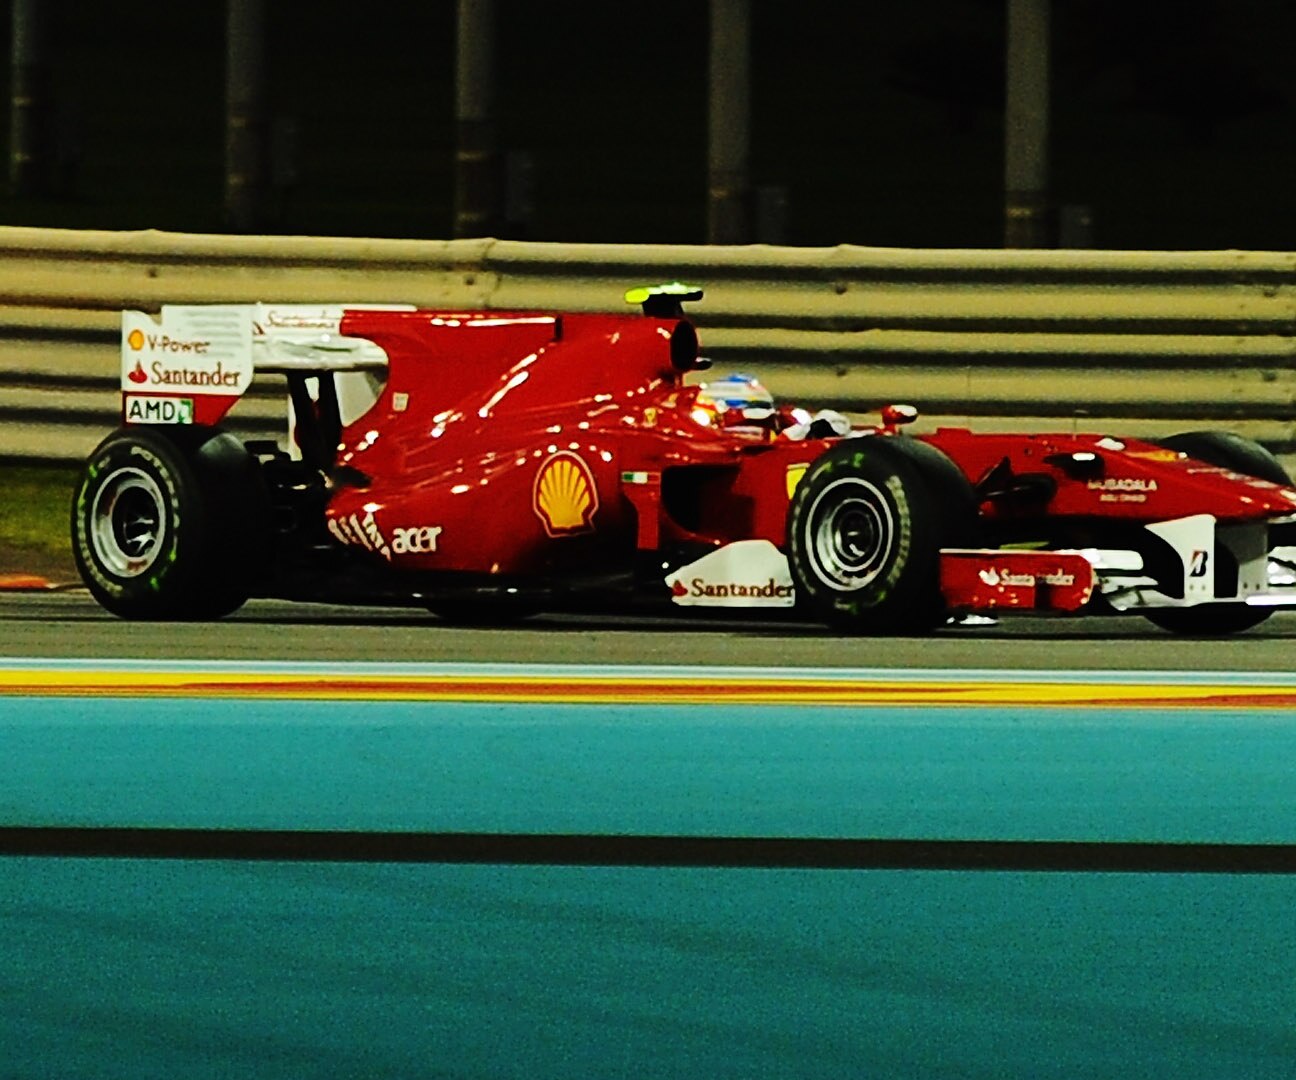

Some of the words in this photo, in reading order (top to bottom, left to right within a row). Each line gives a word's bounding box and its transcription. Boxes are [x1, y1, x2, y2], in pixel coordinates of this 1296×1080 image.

[148, 334, 211, 354] V-Power
[151, 361, 240, 387] Santander
[129, 400, 175, 421] AMD
[392, 526, 442, 553] acer
[691, 578, 795, 598] Santander
